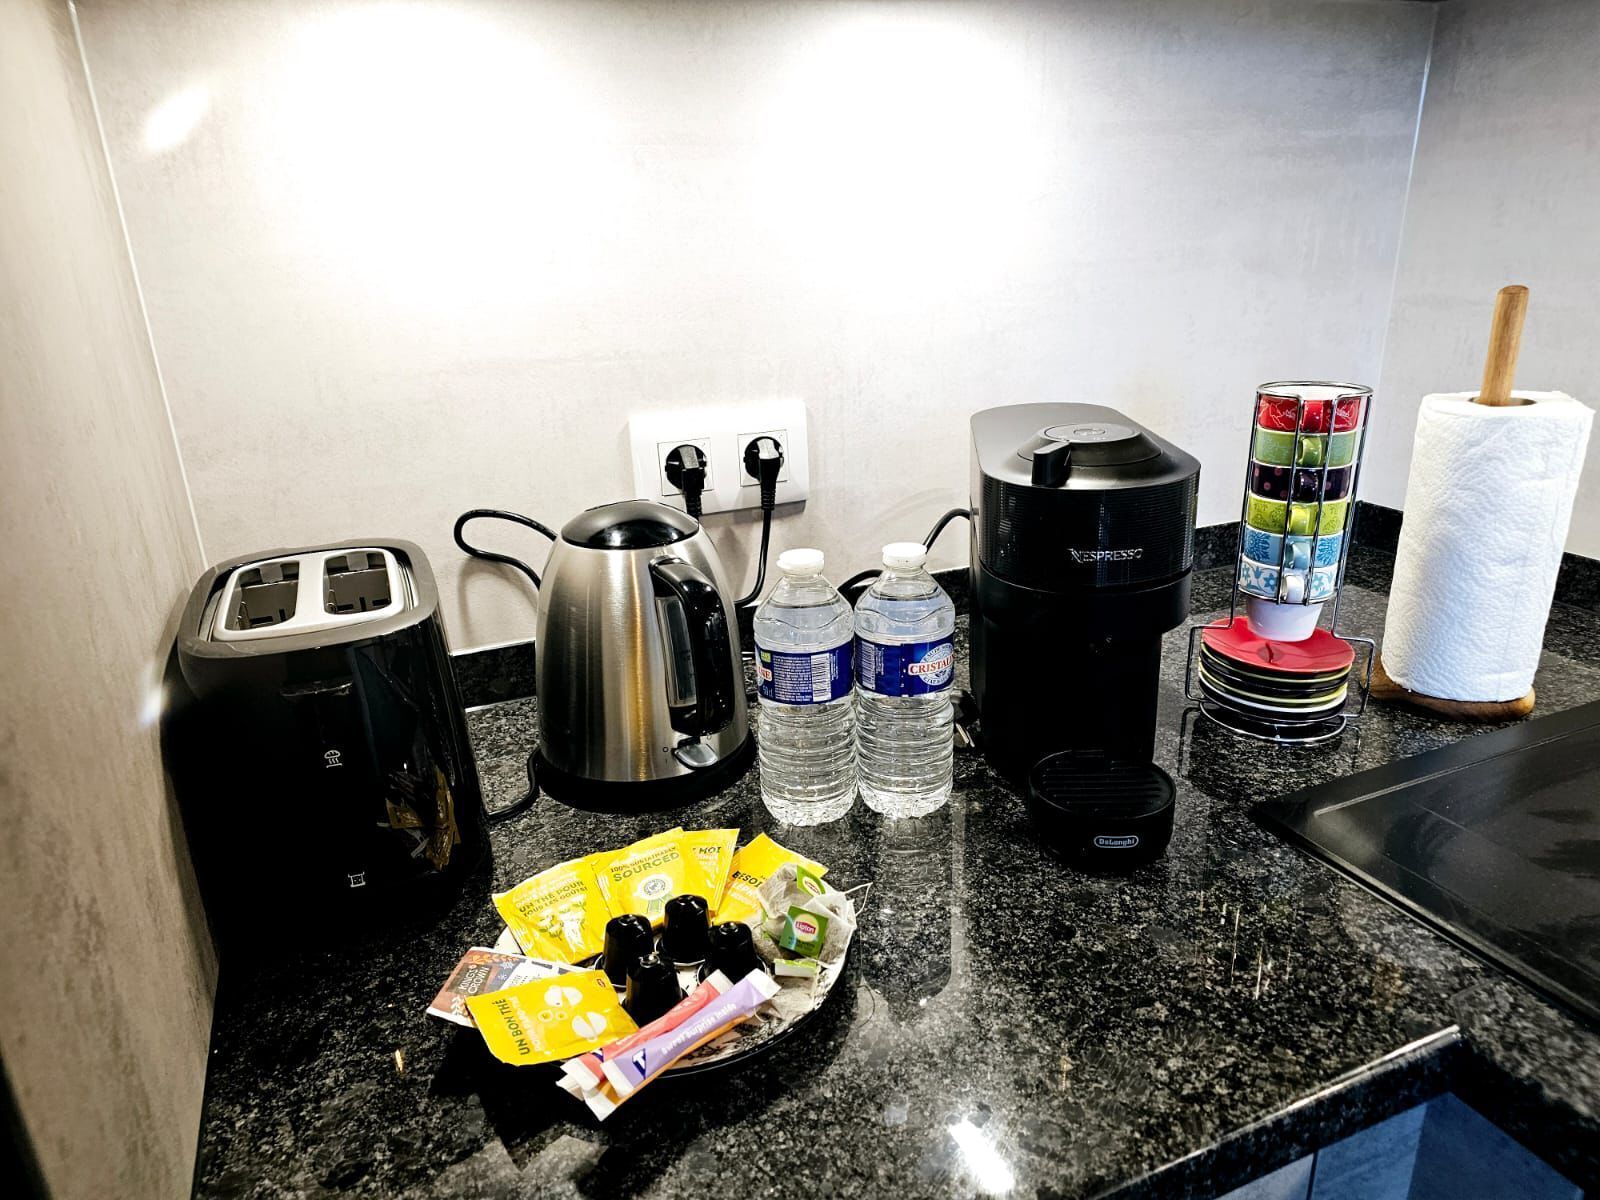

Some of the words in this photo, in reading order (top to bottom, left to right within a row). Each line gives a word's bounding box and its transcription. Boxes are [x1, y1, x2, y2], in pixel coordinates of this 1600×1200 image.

[1067, 548, 1143, 564] NESPRESSO
[612, 851, 680, 882] SOURCED
[732, 870, 763, 888] BESOI
[519, 901, 534, 913] UN
[556, 881, 585, 896] POUR
[467, 966, 491, 994] CROWN
[491, 998, 511, 1016] THÉ
[503, 1015, 523, 1038] BON
[515, 1038, 531, 1056] UN
